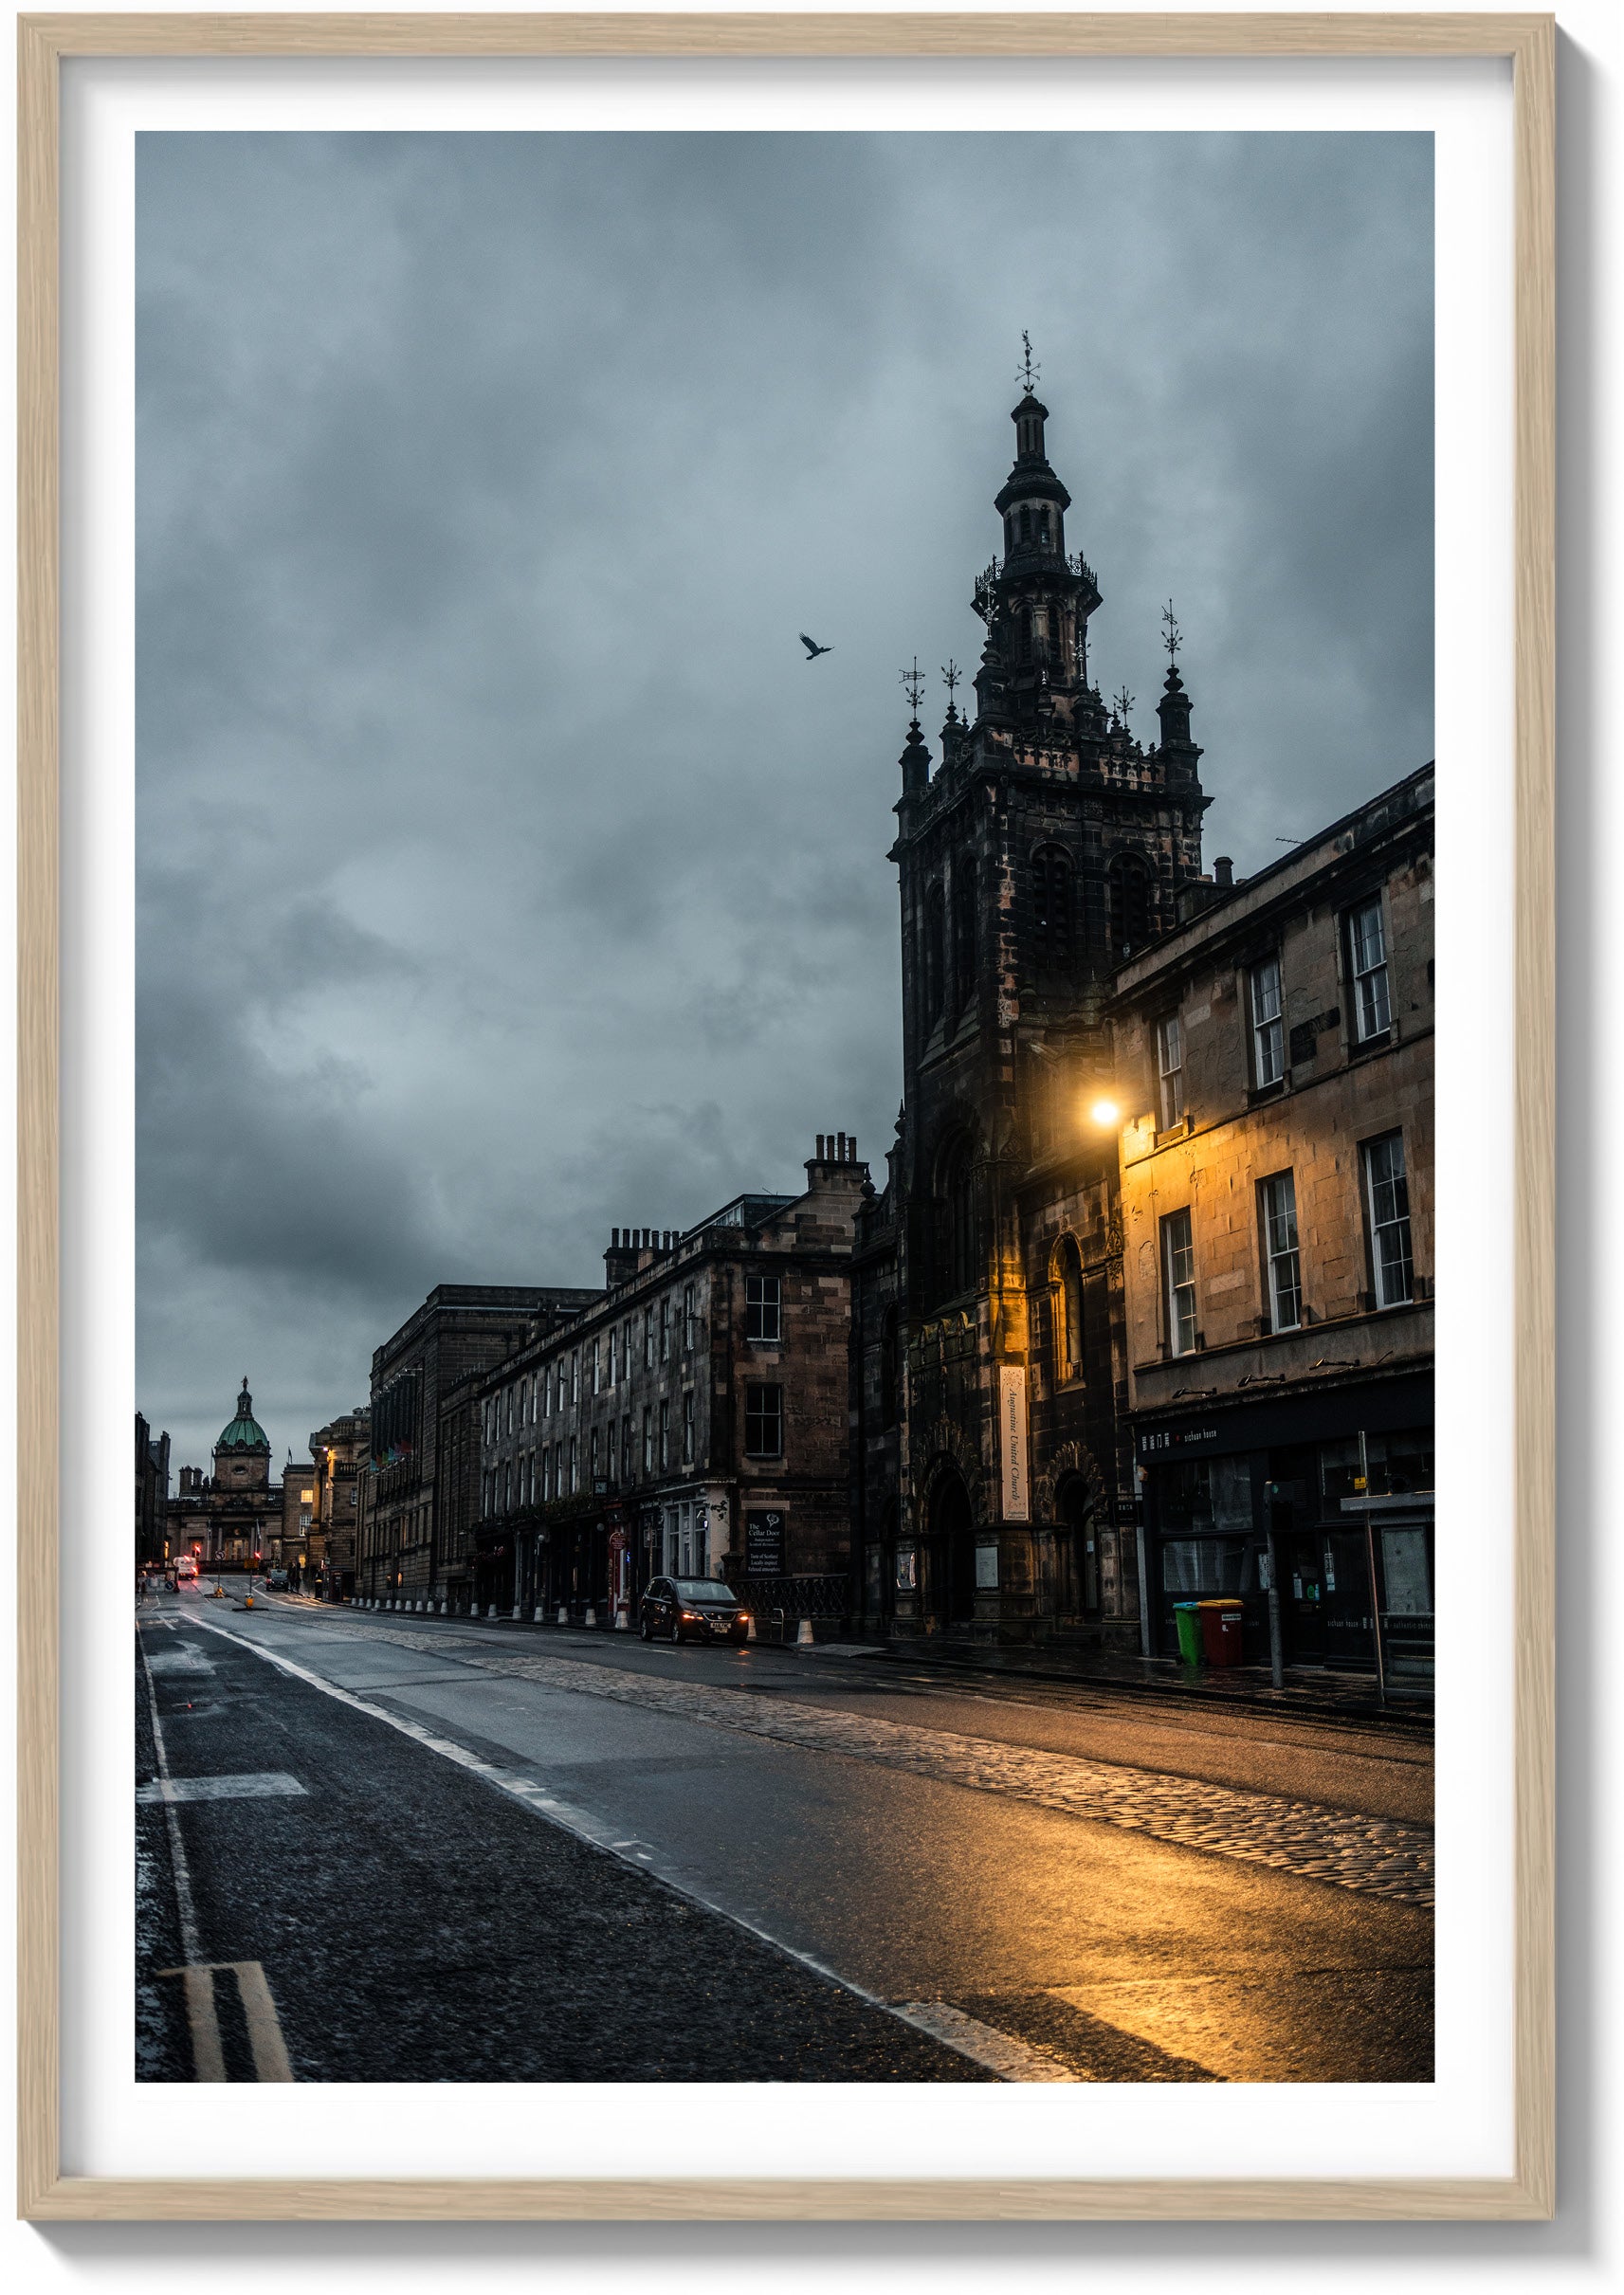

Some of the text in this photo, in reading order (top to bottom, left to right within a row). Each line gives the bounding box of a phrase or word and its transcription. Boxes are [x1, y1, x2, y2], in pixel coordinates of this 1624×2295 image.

[1007, 1388, 1019, 1432] Augustine
[1009, 1435, 1020, 1465] United
[1184, 1428, 1217, 1443] sichuan house
[1011, 1467, 1021, 1501] Church
